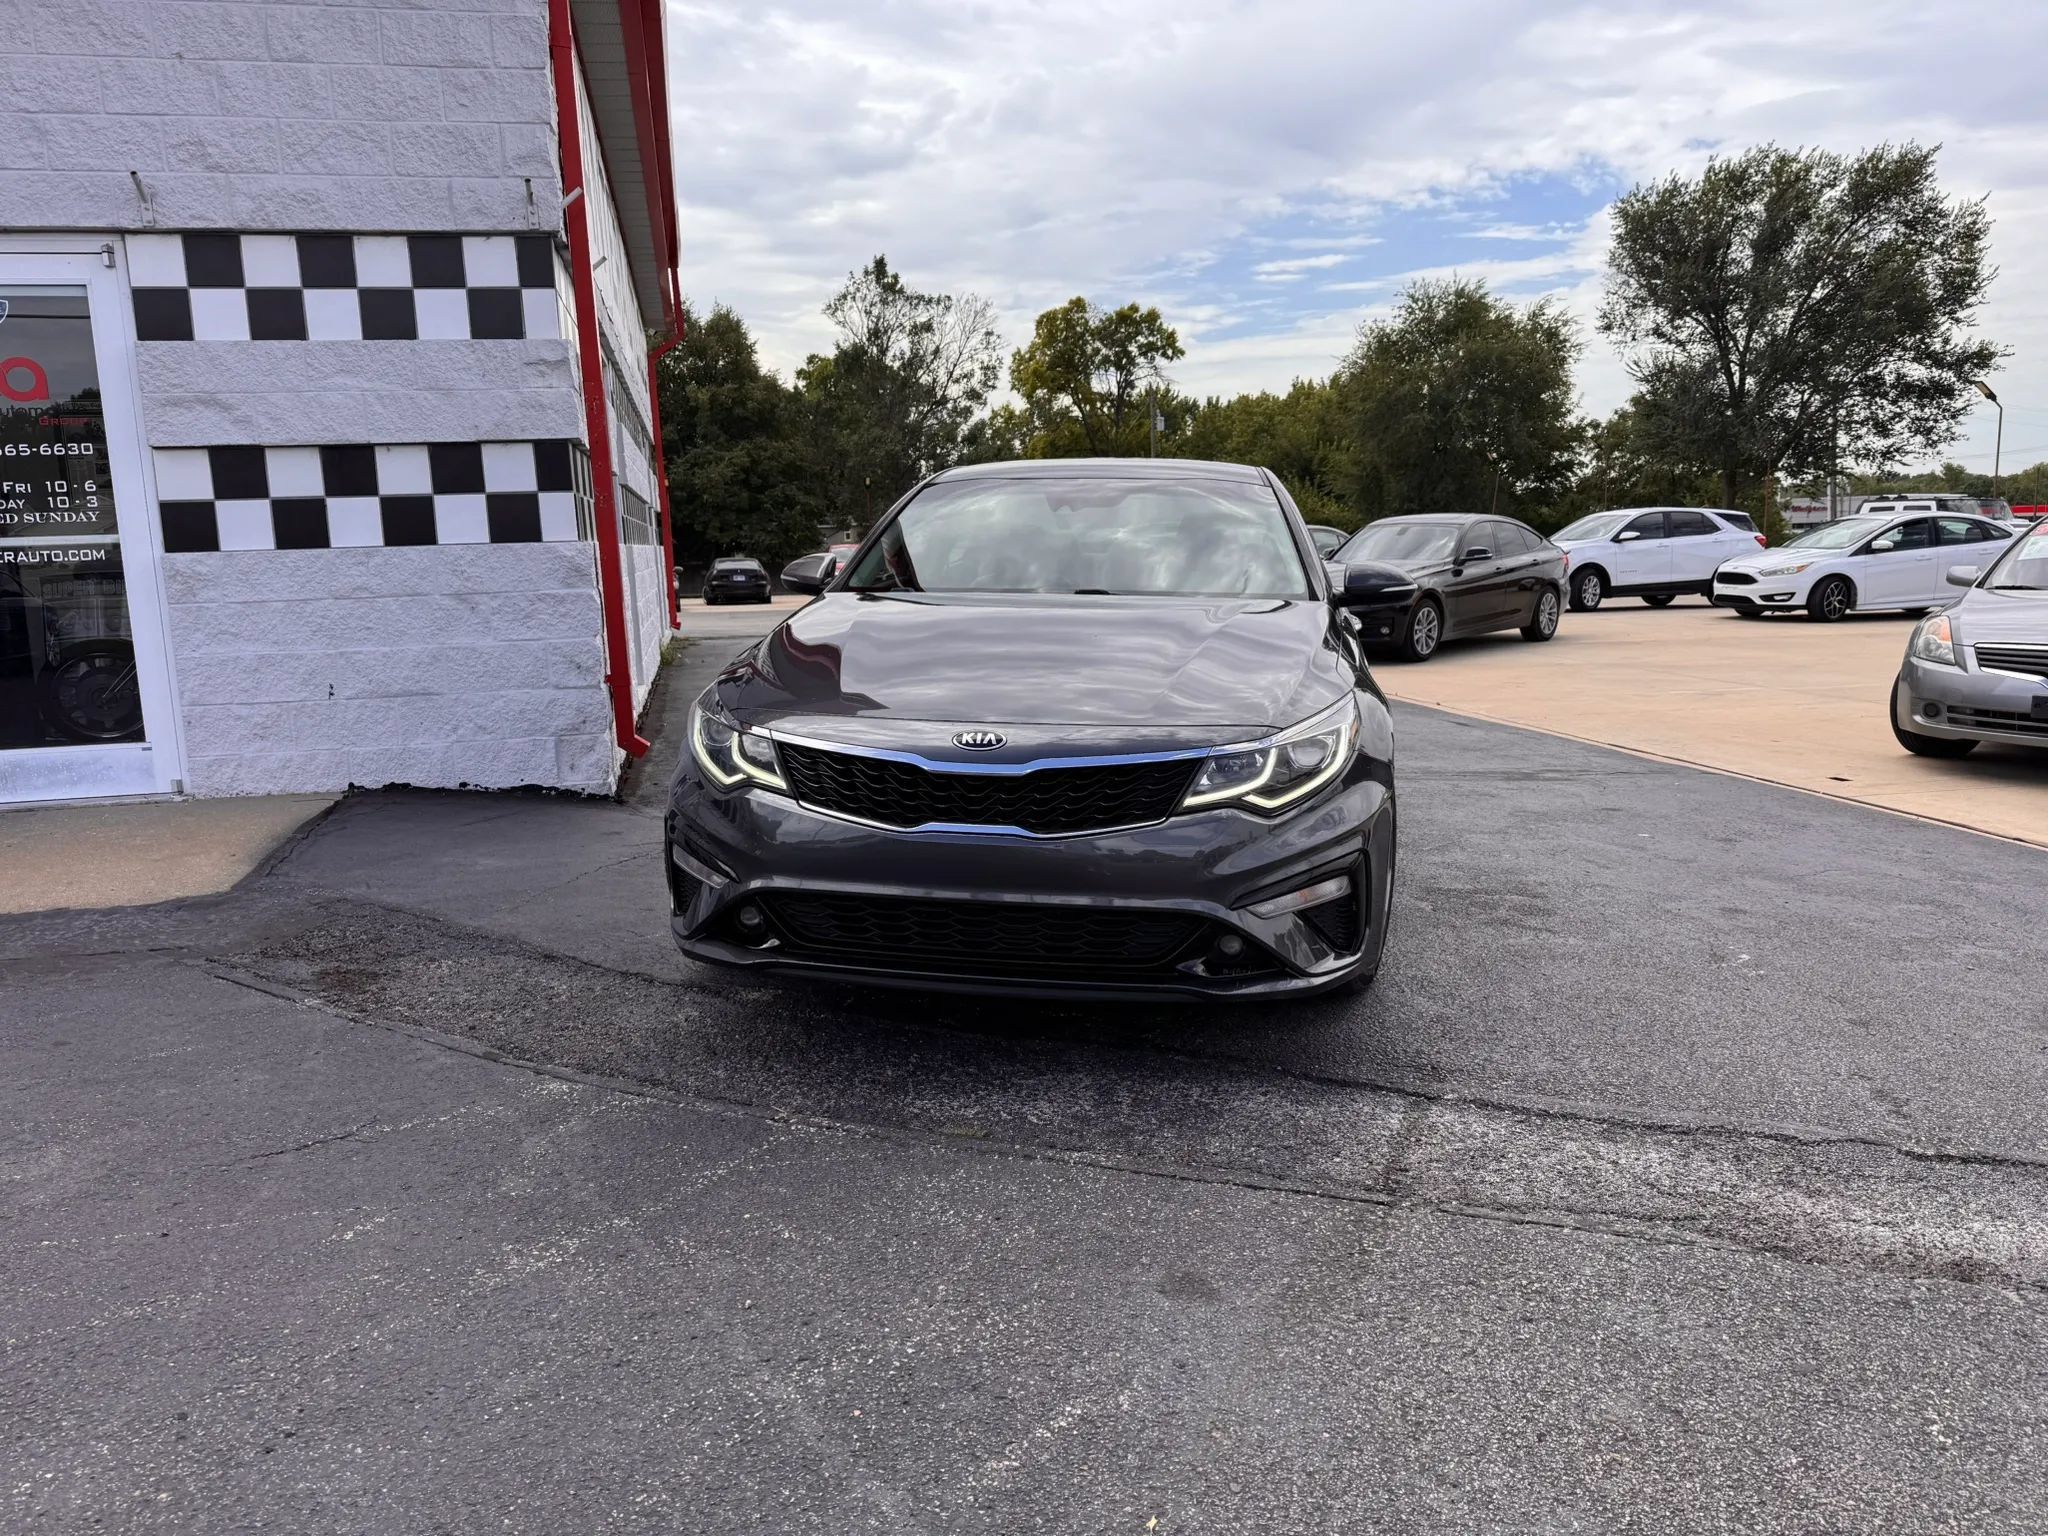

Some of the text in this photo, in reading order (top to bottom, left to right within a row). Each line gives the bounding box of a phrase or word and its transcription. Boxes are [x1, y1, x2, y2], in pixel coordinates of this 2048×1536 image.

[0, 443, 93, 456] 65-6630
[45, 480, 67, 493] 10
[84, 480, 97, 492] 6
[47, 496, 70, 508] 10
[87, 496, 98, 508] 3
[24, 511, 100, 523] SUNDAY
[961, 732, 997, 745] KIA
